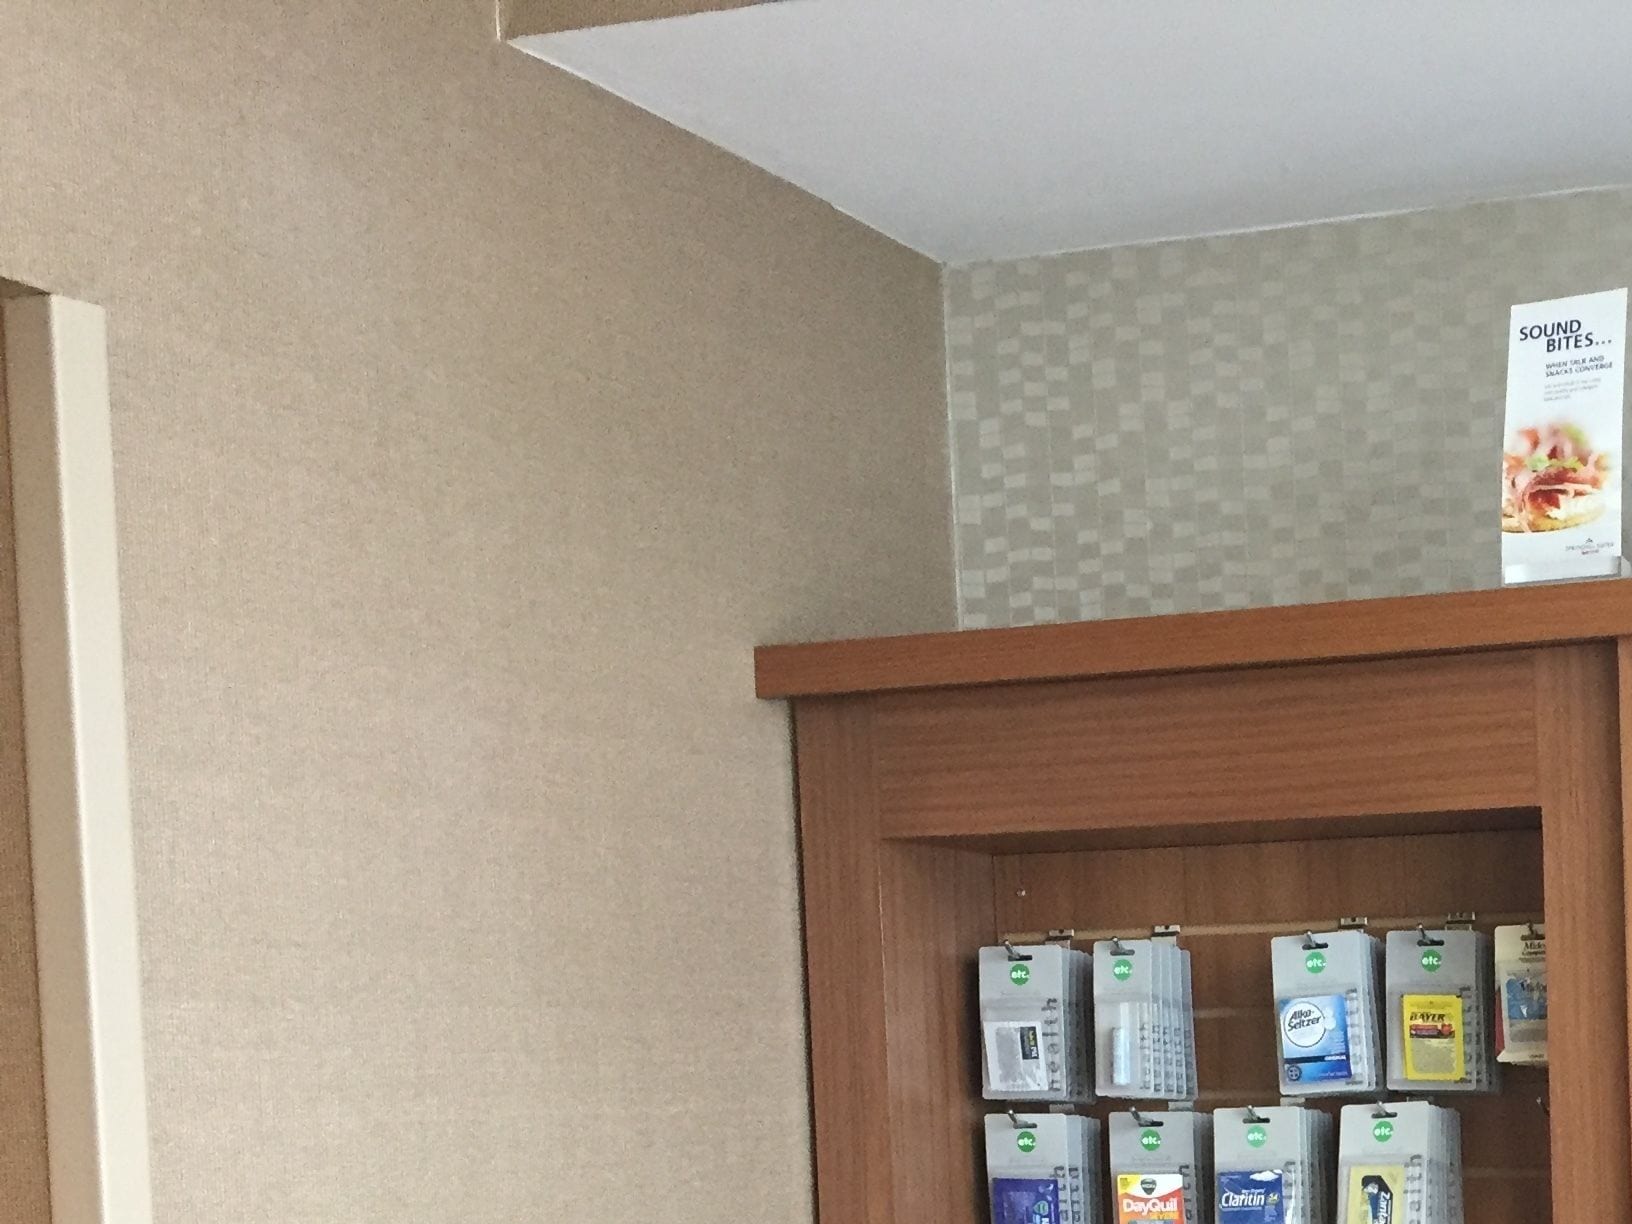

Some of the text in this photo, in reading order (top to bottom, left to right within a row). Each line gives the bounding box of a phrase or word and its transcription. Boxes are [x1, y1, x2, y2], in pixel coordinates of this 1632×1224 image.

[1519, 319, 1582, 342] SOUND
[1546, 332, 1612, 353] BITES...
[1306, 957, 1327, 968] etc.
[1421, 955, 1442, 966] etc.
[1011, 969, 1030, 979] etc.
[1113, 965, 1133, 975] etc.
[1409, 1012, 1446, 1022] BAYER
[1287, 1014, 1321, 1033] Seltzer
[1374, 1127, 1394, 1137] etc.
[1018, 1138, 1036, 1147] etc.
[1140, 1136, 1161, 1145] etc.
[1221, 1191, 1265, 1208] Claritin
[1122, 1198, 1178, 1215] DayQuil
